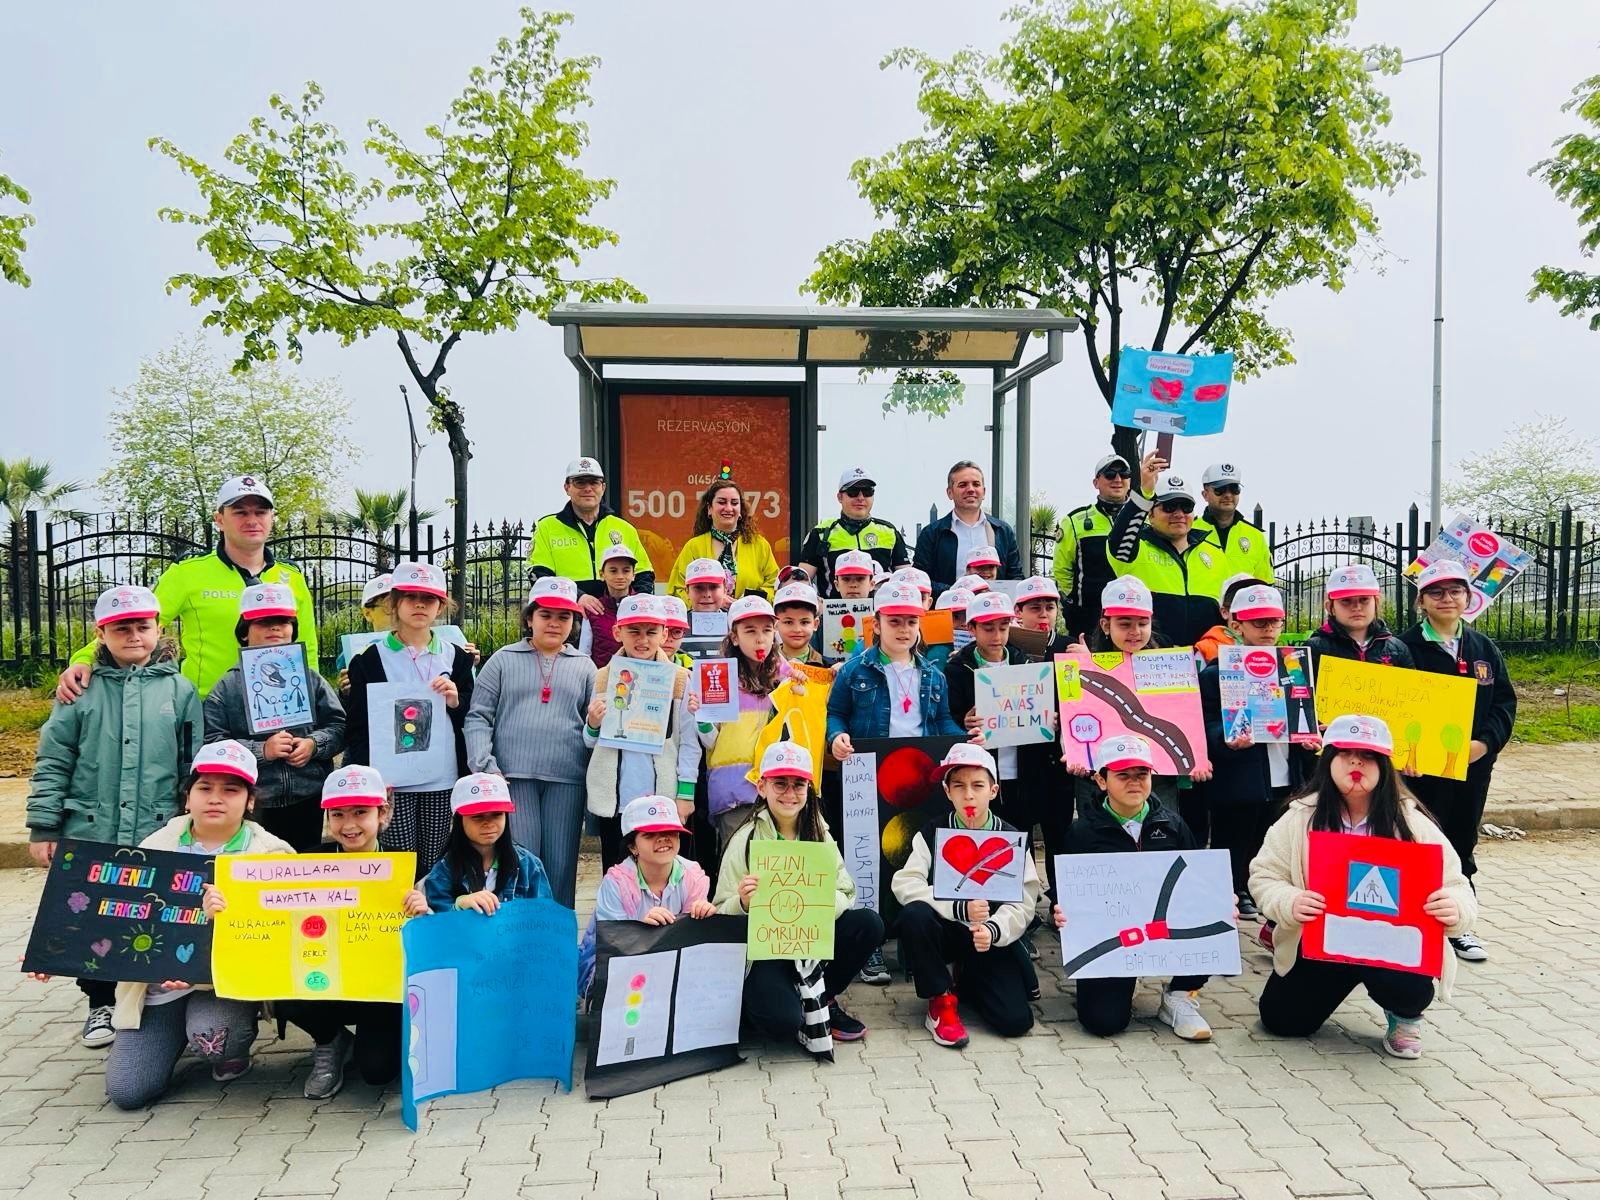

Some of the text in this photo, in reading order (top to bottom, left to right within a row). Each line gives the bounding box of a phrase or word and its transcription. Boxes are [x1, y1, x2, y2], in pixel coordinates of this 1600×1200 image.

[657, 419, 751, 433] REZERVASYON
[687, 473, 721, 485] 0(454
[628, 490, 686, 518] 500
[257, 717, 285, 730] KASK
[1075, 725, 1093, 733] DUR
[844, 774, 875, 784] KURAL
[849, 790, 864, 801] BİR
[846, 808, 876, 819] HAYAT
[757, 855, 805, 871] HIZINI
[88, 862, 157, 889] GÜVENLİ
[246, 863, 382, 881] KURALLARA UY
[1065, 864, 1118, 880] HAYATA
[769, 872, 828, 888] AZALT
[1065, 881, 1143, 897] TUTUNMAK
[265, 891, 317, 905] HAYATTA
[346, 923, 370, 932] LARI
[756, 923, 819, 942] ÖMRÜNÜ
[234, 932, 271, 941] UYALIM
[302, 950, 328, 958] BEKLE
[770, 940, 815, 955] UZAT
[1125, 953, 1144, 971] BİR
[1175, 950, 1221, 967] YETER
